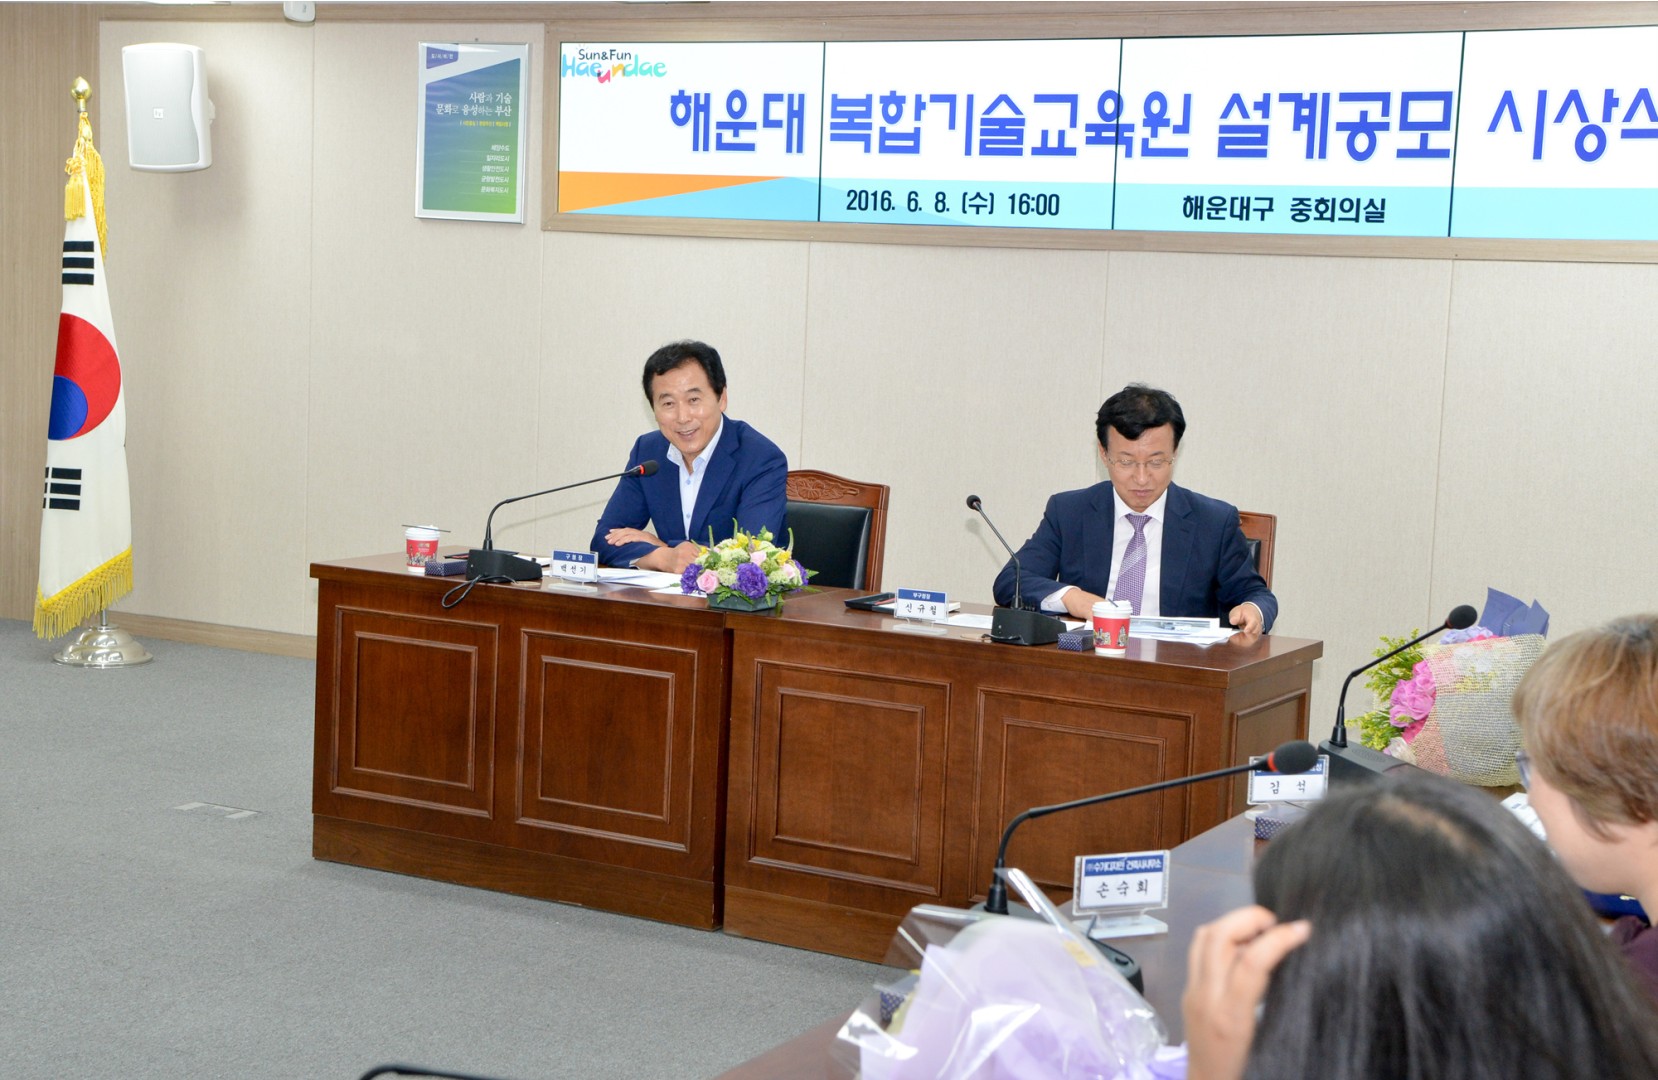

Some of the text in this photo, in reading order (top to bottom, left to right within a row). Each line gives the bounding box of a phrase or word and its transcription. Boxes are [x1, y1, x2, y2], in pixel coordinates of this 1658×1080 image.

[578, 48, 631, 60] Sun&Fun
[562, 53, 667, 83] Haeundae
[495, 105, 512, 117] 부산
[671, 90, 805, 154] 해운대
[830, 89, 1191, 158] 복합기술교육원
[1217, 91, 1453, 162] 설계공모
[846, 189, 896, 212] 2016.
[907, 191, 922, 212] 6.
[934, 191, 950, 213] 8.
[1008, 193, 1060, 216] 16:00
[1183, 195, 1386, 223] 해운대구 중회의실
